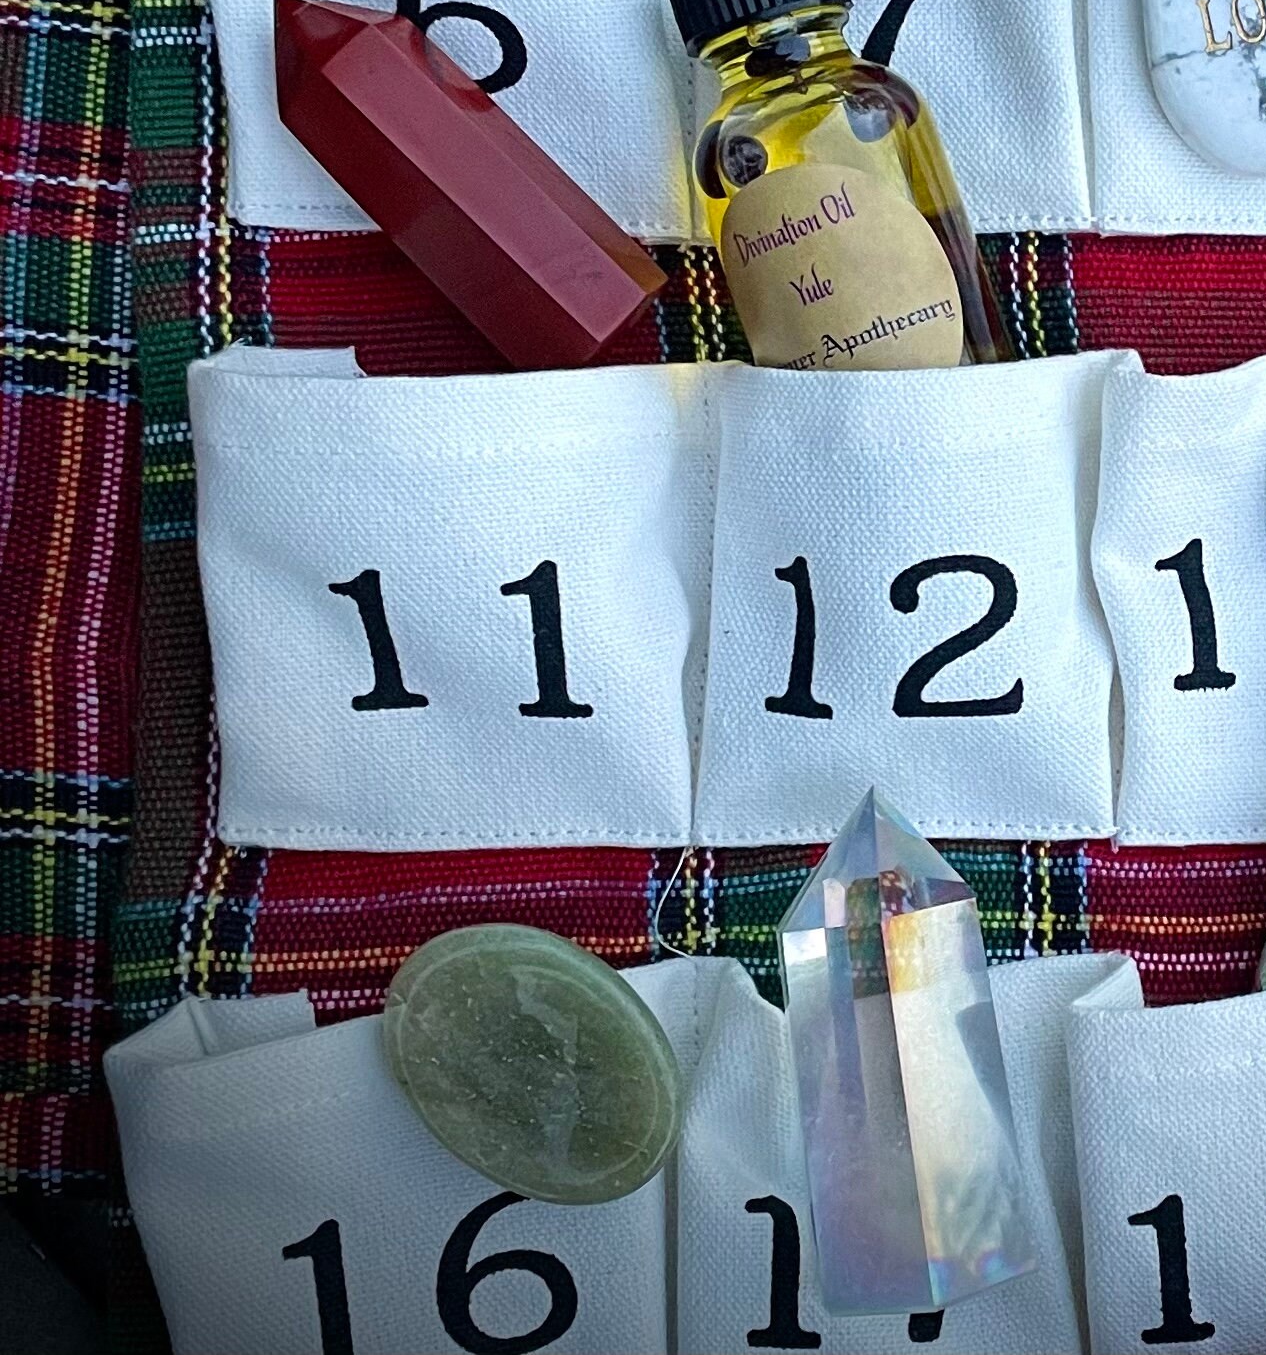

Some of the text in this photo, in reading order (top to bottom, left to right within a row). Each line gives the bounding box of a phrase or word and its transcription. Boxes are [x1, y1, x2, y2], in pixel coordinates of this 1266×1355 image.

[732, 181, 856, 268] Divination Oil
[789, 266, 835, 308] Yule
[820, 299, 956, 366] Apothecary
[328, 559, 595, 719] 11
[764, 554, 1025, 720] 12
[282, 1190, 579, 1355] 16
